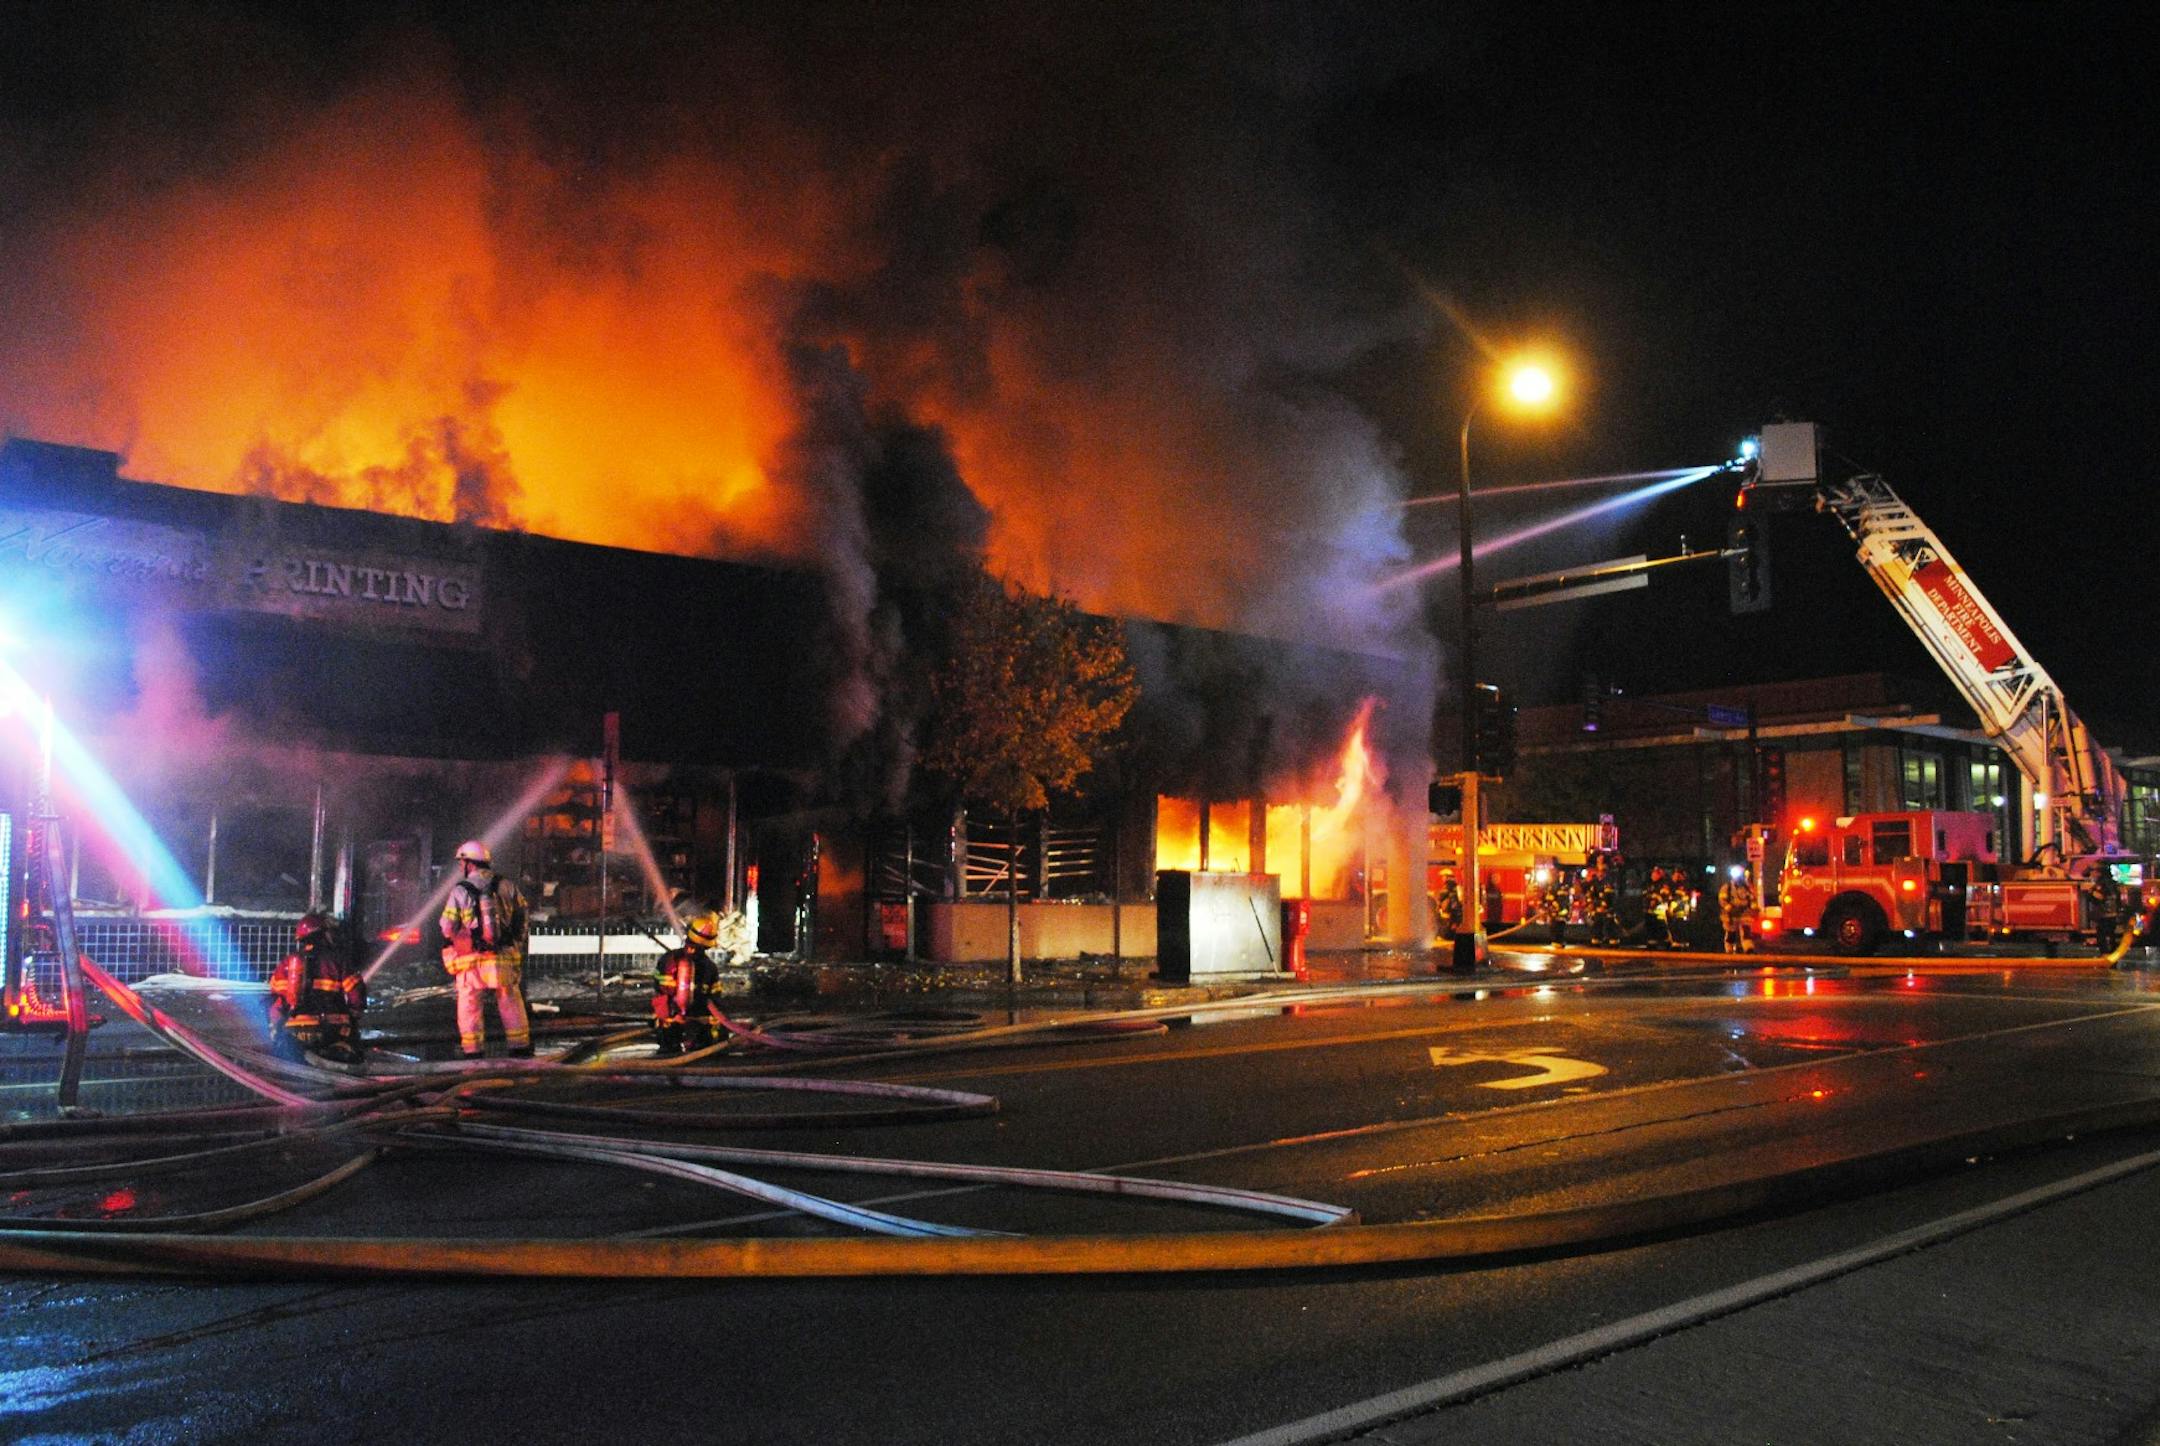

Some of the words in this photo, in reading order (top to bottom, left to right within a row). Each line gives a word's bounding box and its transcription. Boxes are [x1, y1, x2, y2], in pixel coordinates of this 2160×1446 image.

[1928, 588, 1982, 653] DEPARTMENT
[1945, 575, 2000, 643] MINNEAPOLIS
[1953, 603, 1975, 626] FIRE
